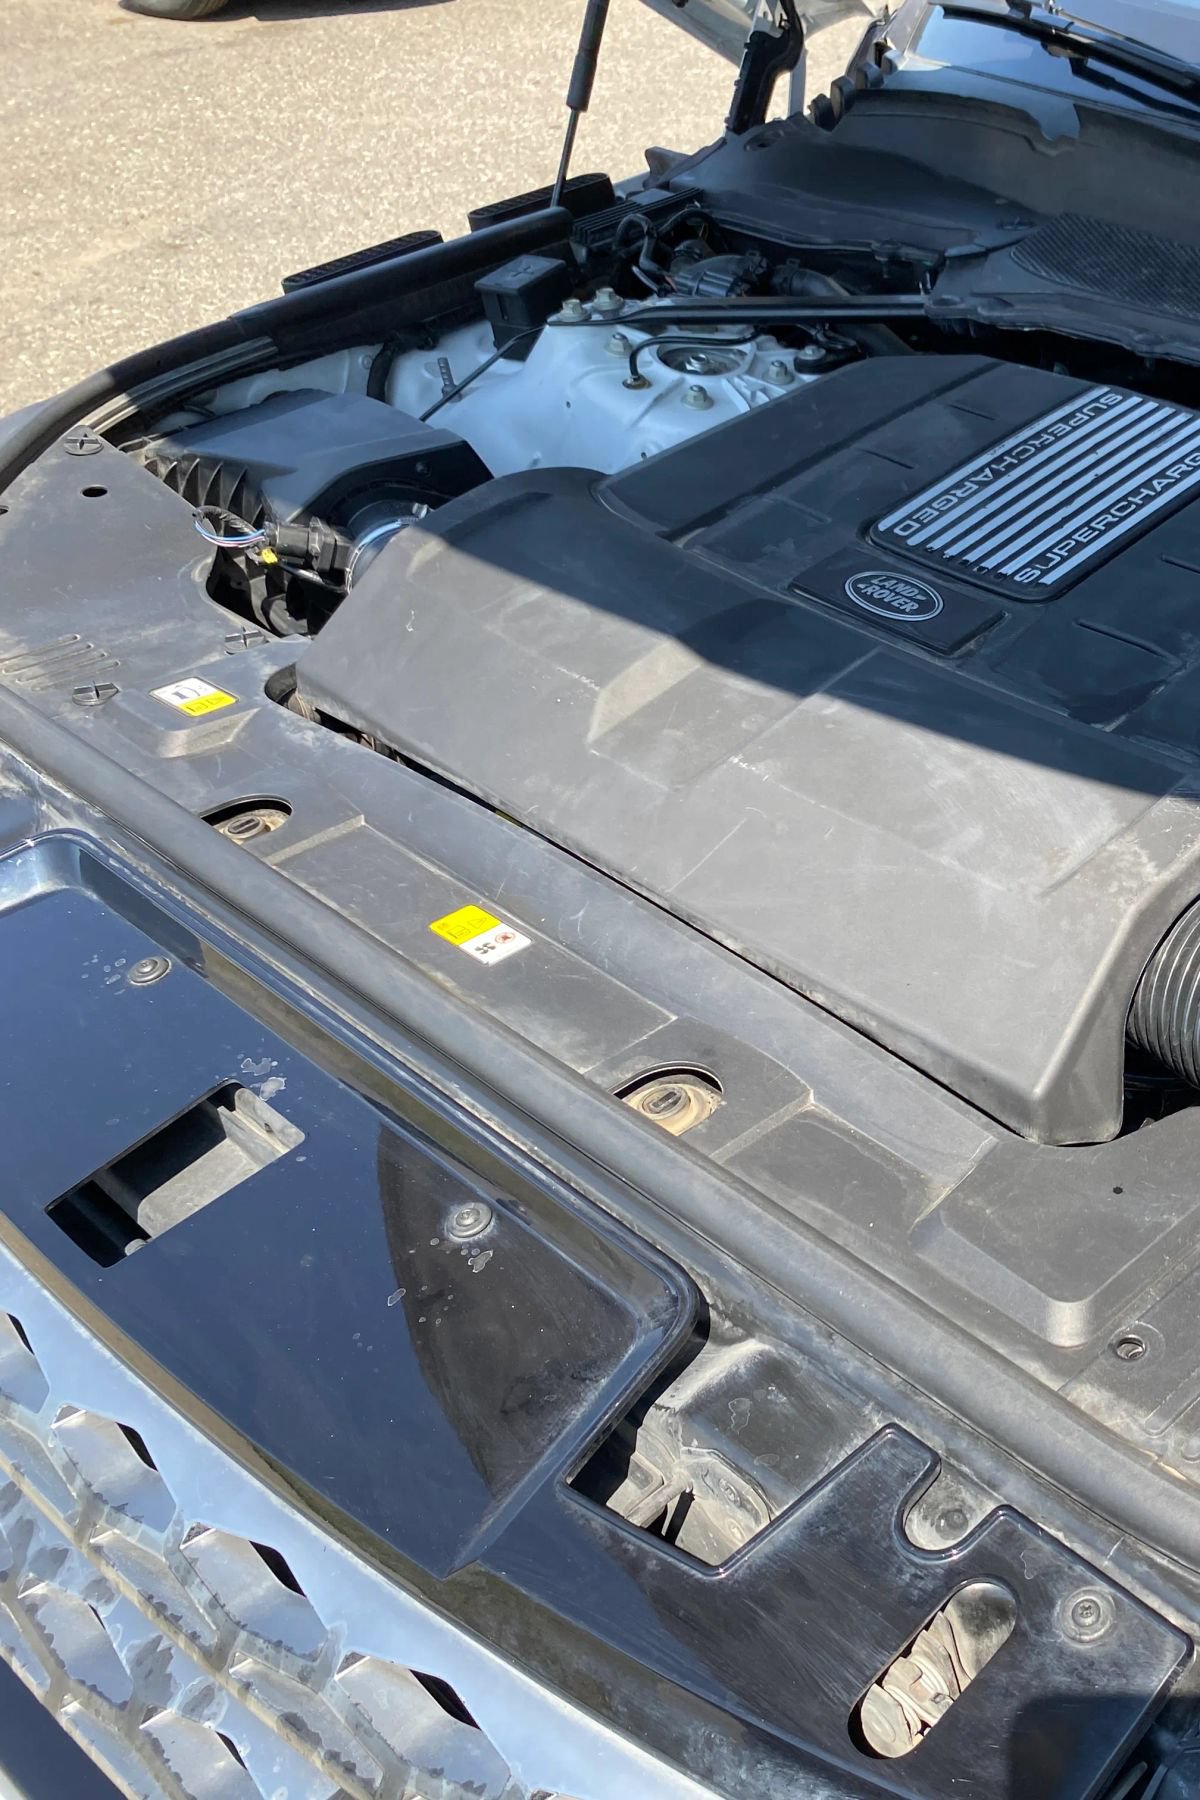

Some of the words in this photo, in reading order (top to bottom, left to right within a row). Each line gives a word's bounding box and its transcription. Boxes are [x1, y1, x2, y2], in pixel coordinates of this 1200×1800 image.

[894, 392, 1123, 537] SUPERCHARGED
[861, 584, 919, 612] ROVER
[870, 576, 919, 597] LAND
